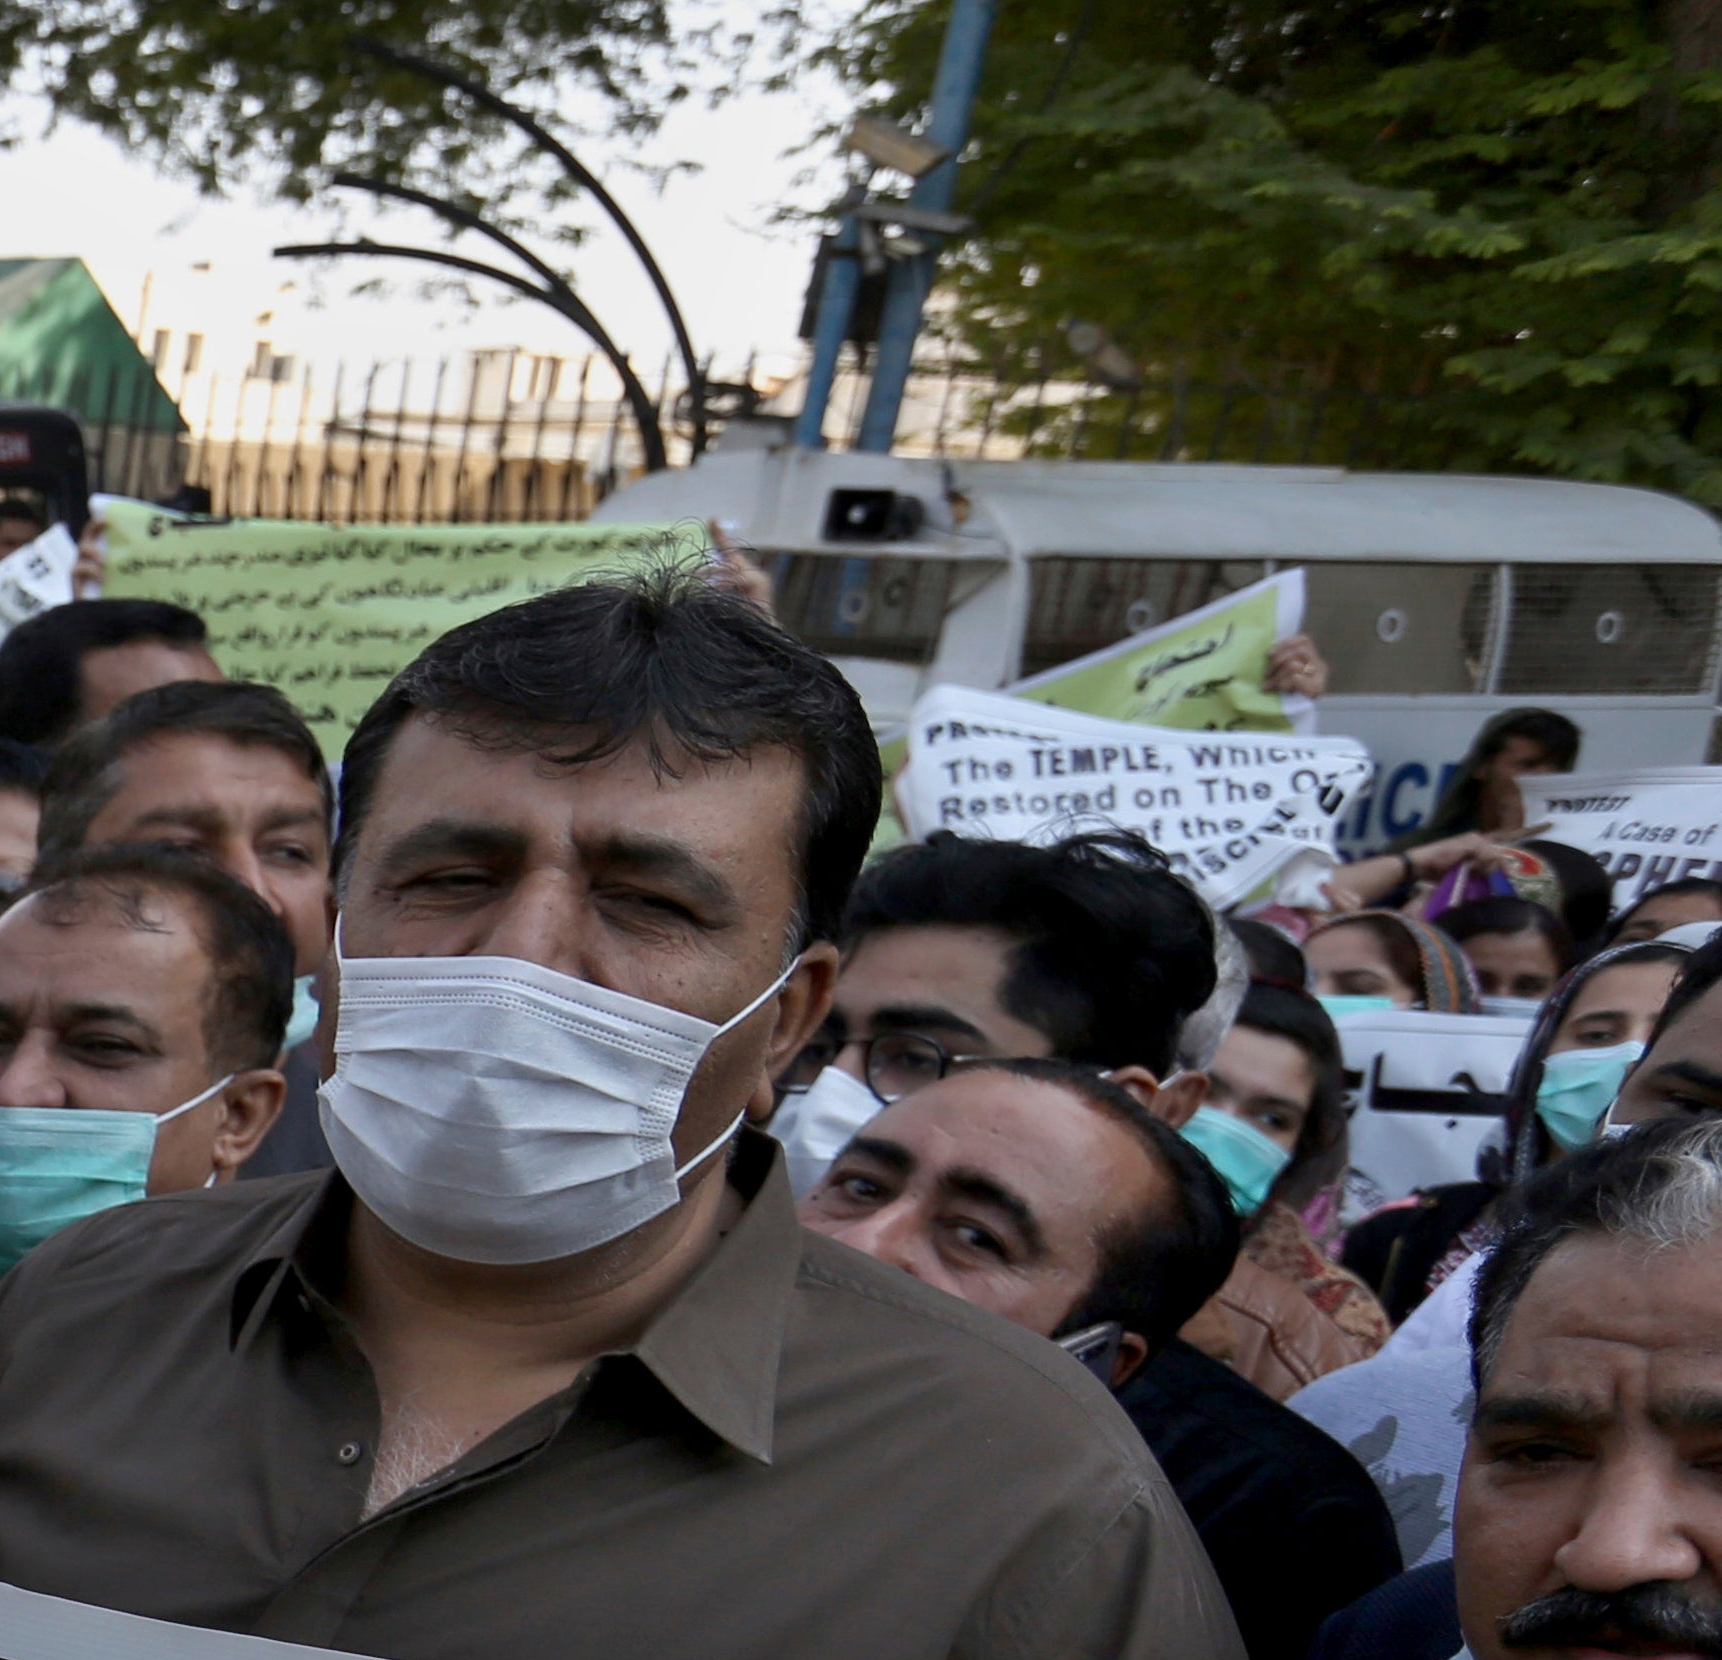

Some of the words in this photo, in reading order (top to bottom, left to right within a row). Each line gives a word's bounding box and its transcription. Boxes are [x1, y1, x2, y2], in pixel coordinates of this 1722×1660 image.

[1134, 621, 1236, 694] احتجاج
[941, 757, 1015, 785] The
[1030, 745, 1175, 778] TEMPLE,
[939, 786, 1116, 824] Restored
[1133, 784, 1183, 809] on
[1198, 777, 1272, 803] The
[1544, 795, 1632, 815] PROTEST
[1181, 816, 1245, 840] the
[1619, 820, 1673, 844] Case
[1684, 823, 1715, 846] of
